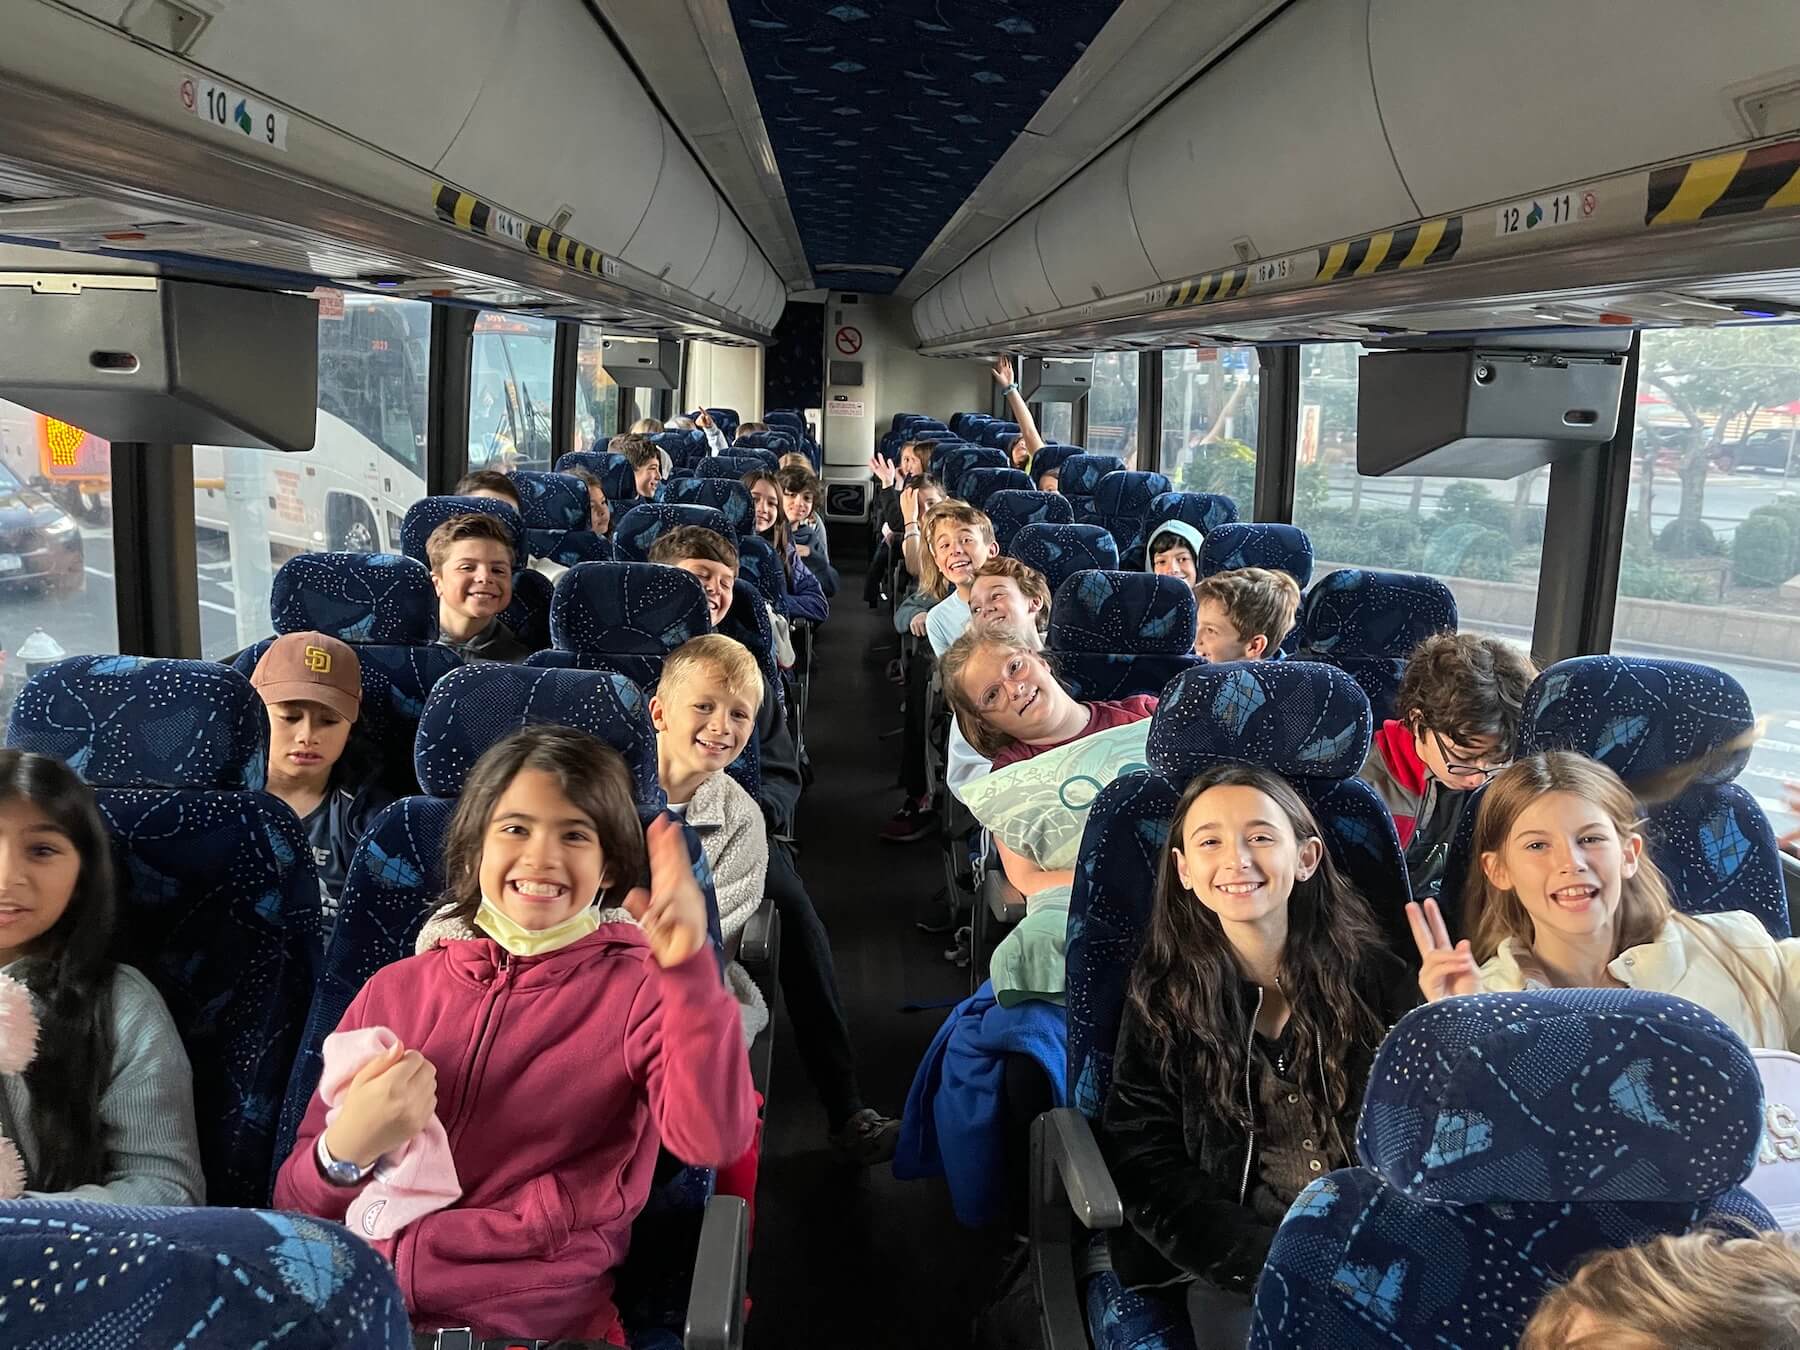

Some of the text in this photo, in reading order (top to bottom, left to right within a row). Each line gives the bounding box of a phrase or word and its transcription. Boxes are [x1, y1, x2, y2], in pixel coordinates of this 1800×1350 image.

[207, 88, 275, 144] 10 9
[1504, 195, 1570, 234] 12 11
[1278, 260, 1287, 278] 15
[305, 645, 332, 673] SD
[312, 846, 331, 867] E
